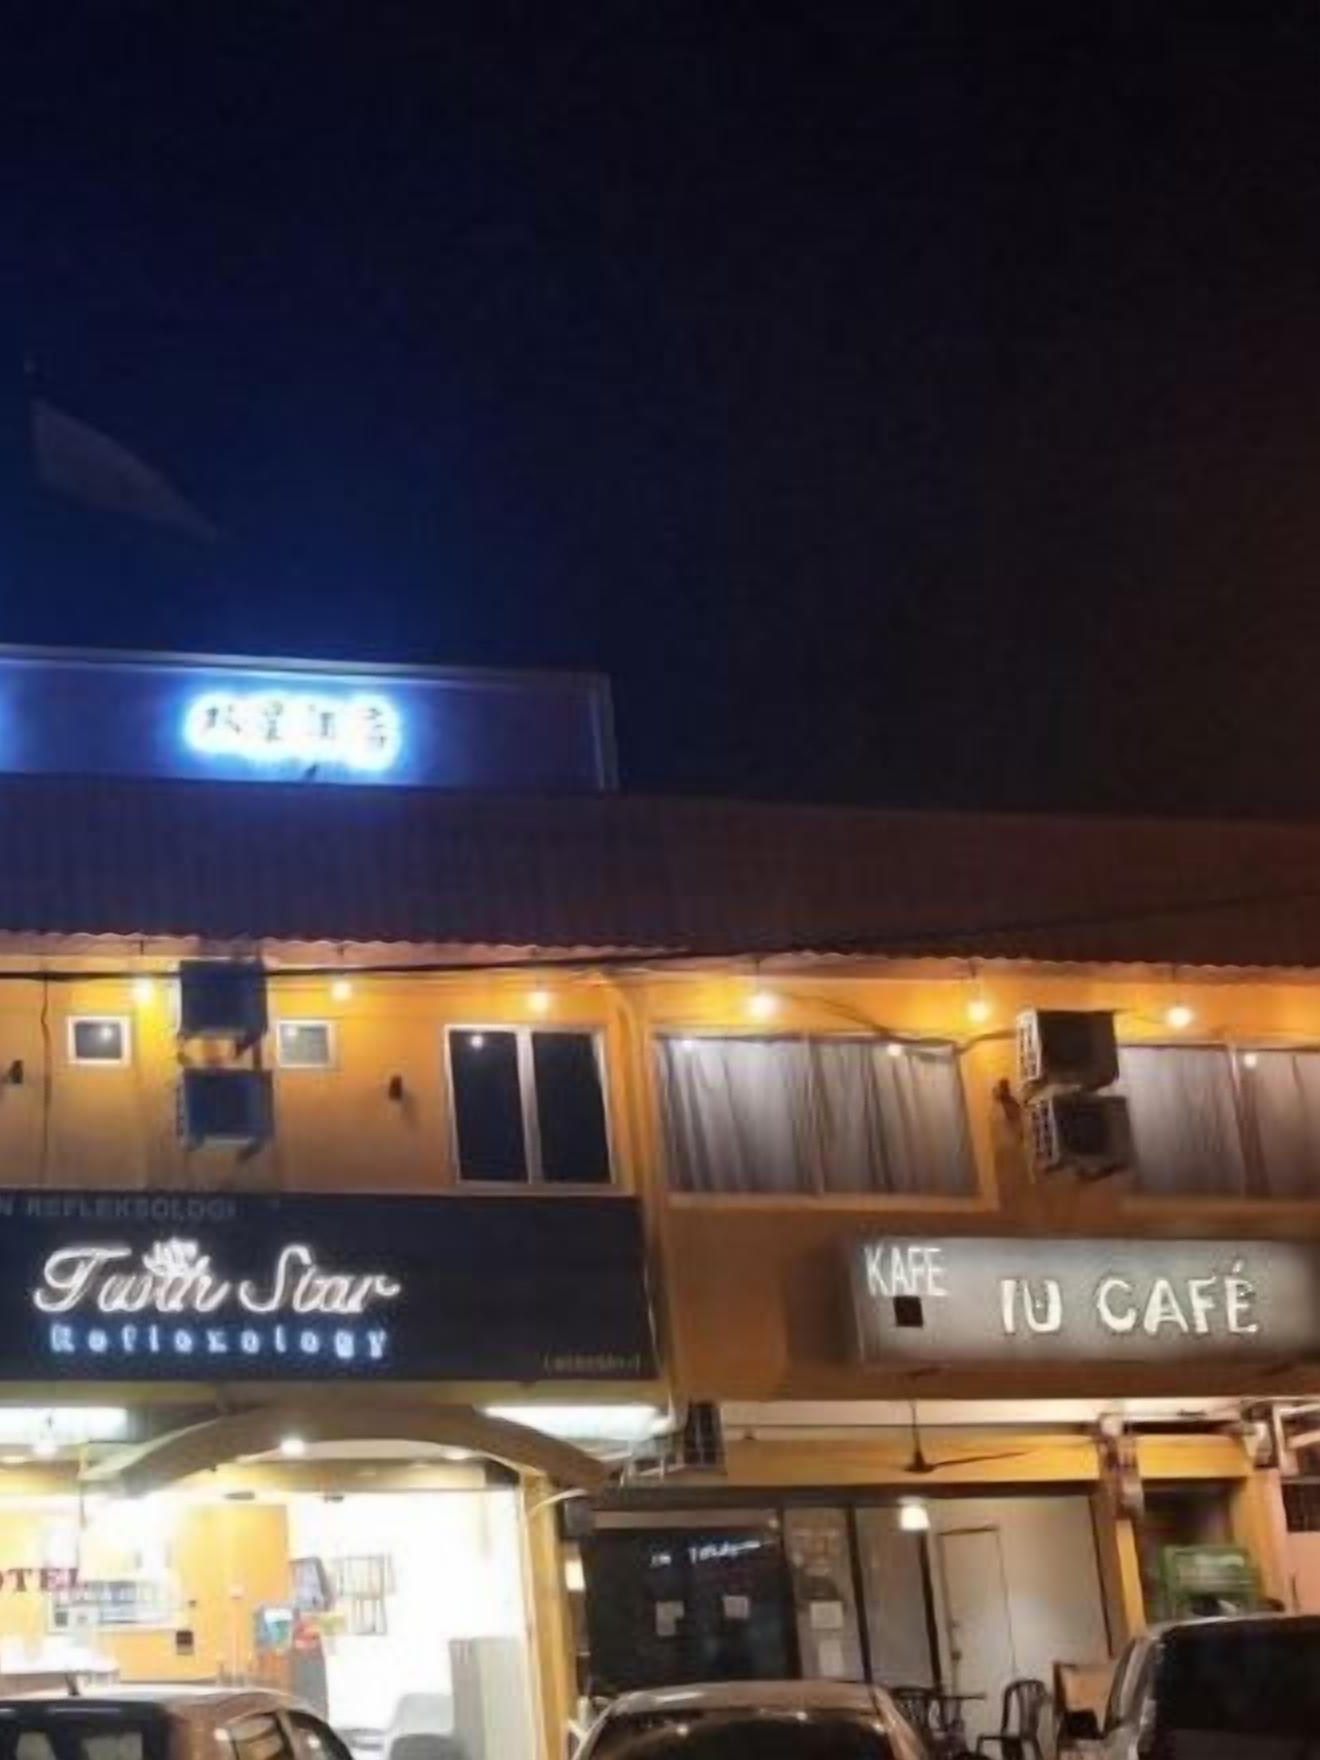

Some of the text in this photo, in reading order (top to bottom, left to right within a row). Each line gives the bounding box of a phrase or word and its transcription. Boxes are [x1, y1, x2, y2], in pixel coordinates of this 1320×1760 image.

[27, 1196, 237, 1220] REFLEKSOLOGI
[32, 1240, 401, 1314] Twin Star
[864, 1246, 948, 1297] KAFE
[1000, 1258, 1259, 1335] IU CAFÉ
[50, 1323, 388, 1359] Reflexology
